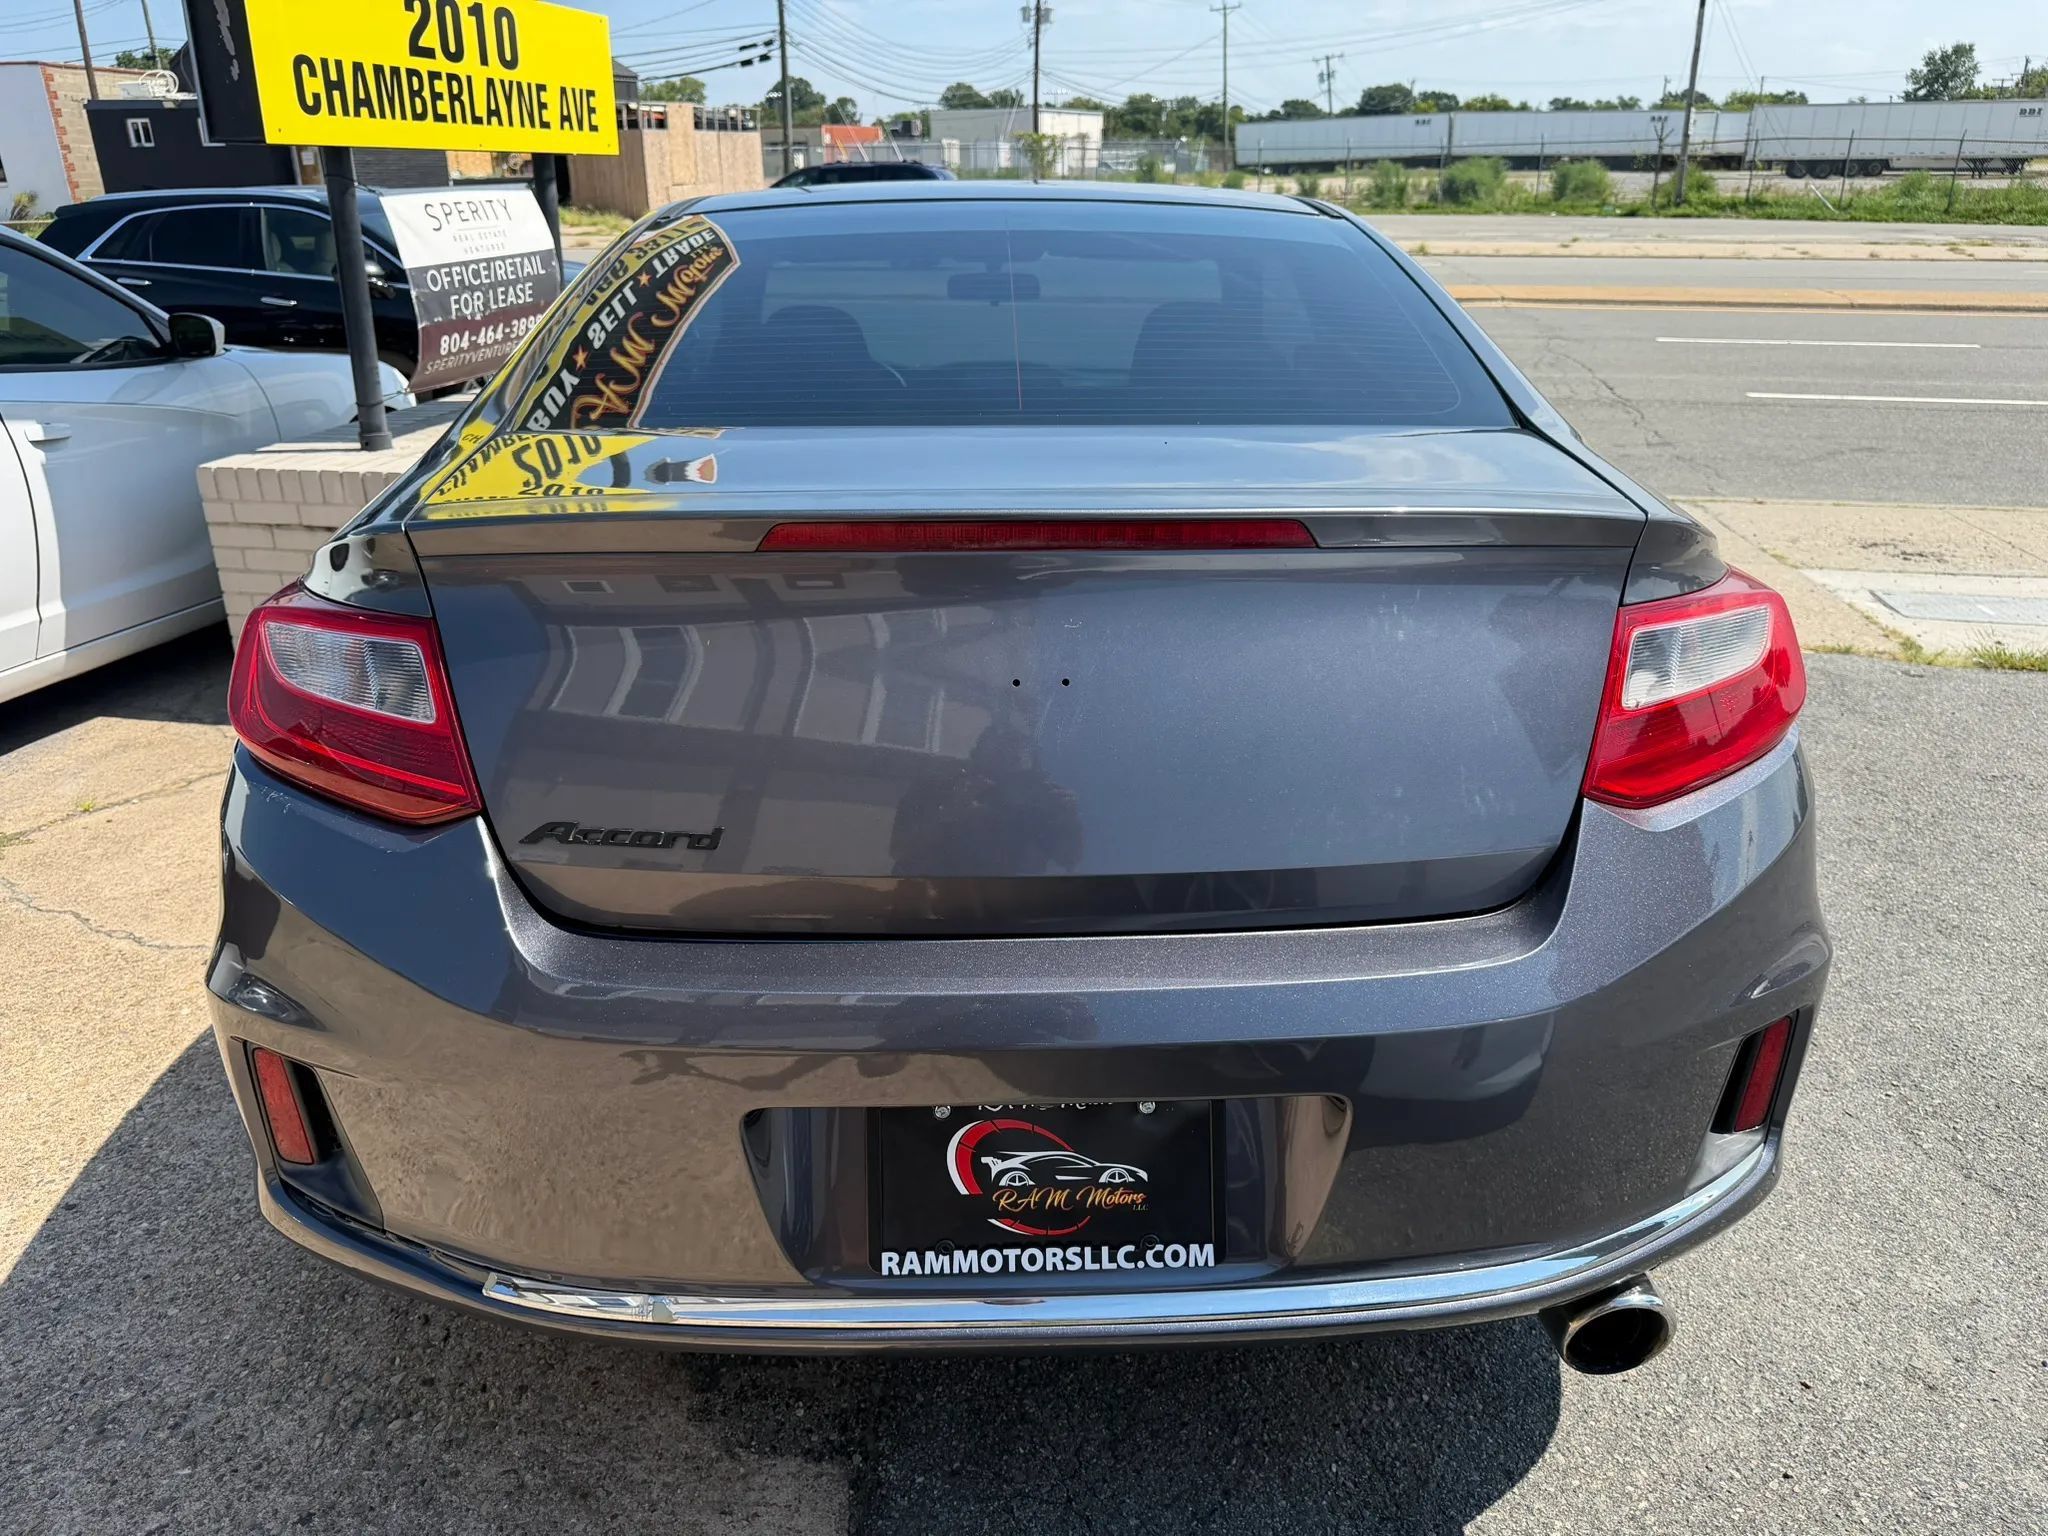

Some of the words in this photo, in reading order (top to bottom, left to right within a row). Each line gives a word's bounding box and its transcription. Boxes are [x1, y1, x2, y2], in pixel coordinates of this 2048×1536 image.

[405, 0, 519, 71] 2010
[293, 53, 551, 130] CHAMBERLAYNE
[559, 86, 600, 133] AVE
[424, 198, 513, 232] SPERITY
[426, 255, 546, 292] OFFICE/RETAIL
[450, 291, 485, 318] FOR
[489, 282, 533, 311] LEASE
[424, 340, 522, 375] SPERITYVENTURE
[518, 821, 726, 851] Accord
[992, 1187, 1074, 1213] RAM
[1076, 1185, 1148, 1211] Motors
[881, 1243, 1216, 1277] RAMMOTORSLLC.COM
